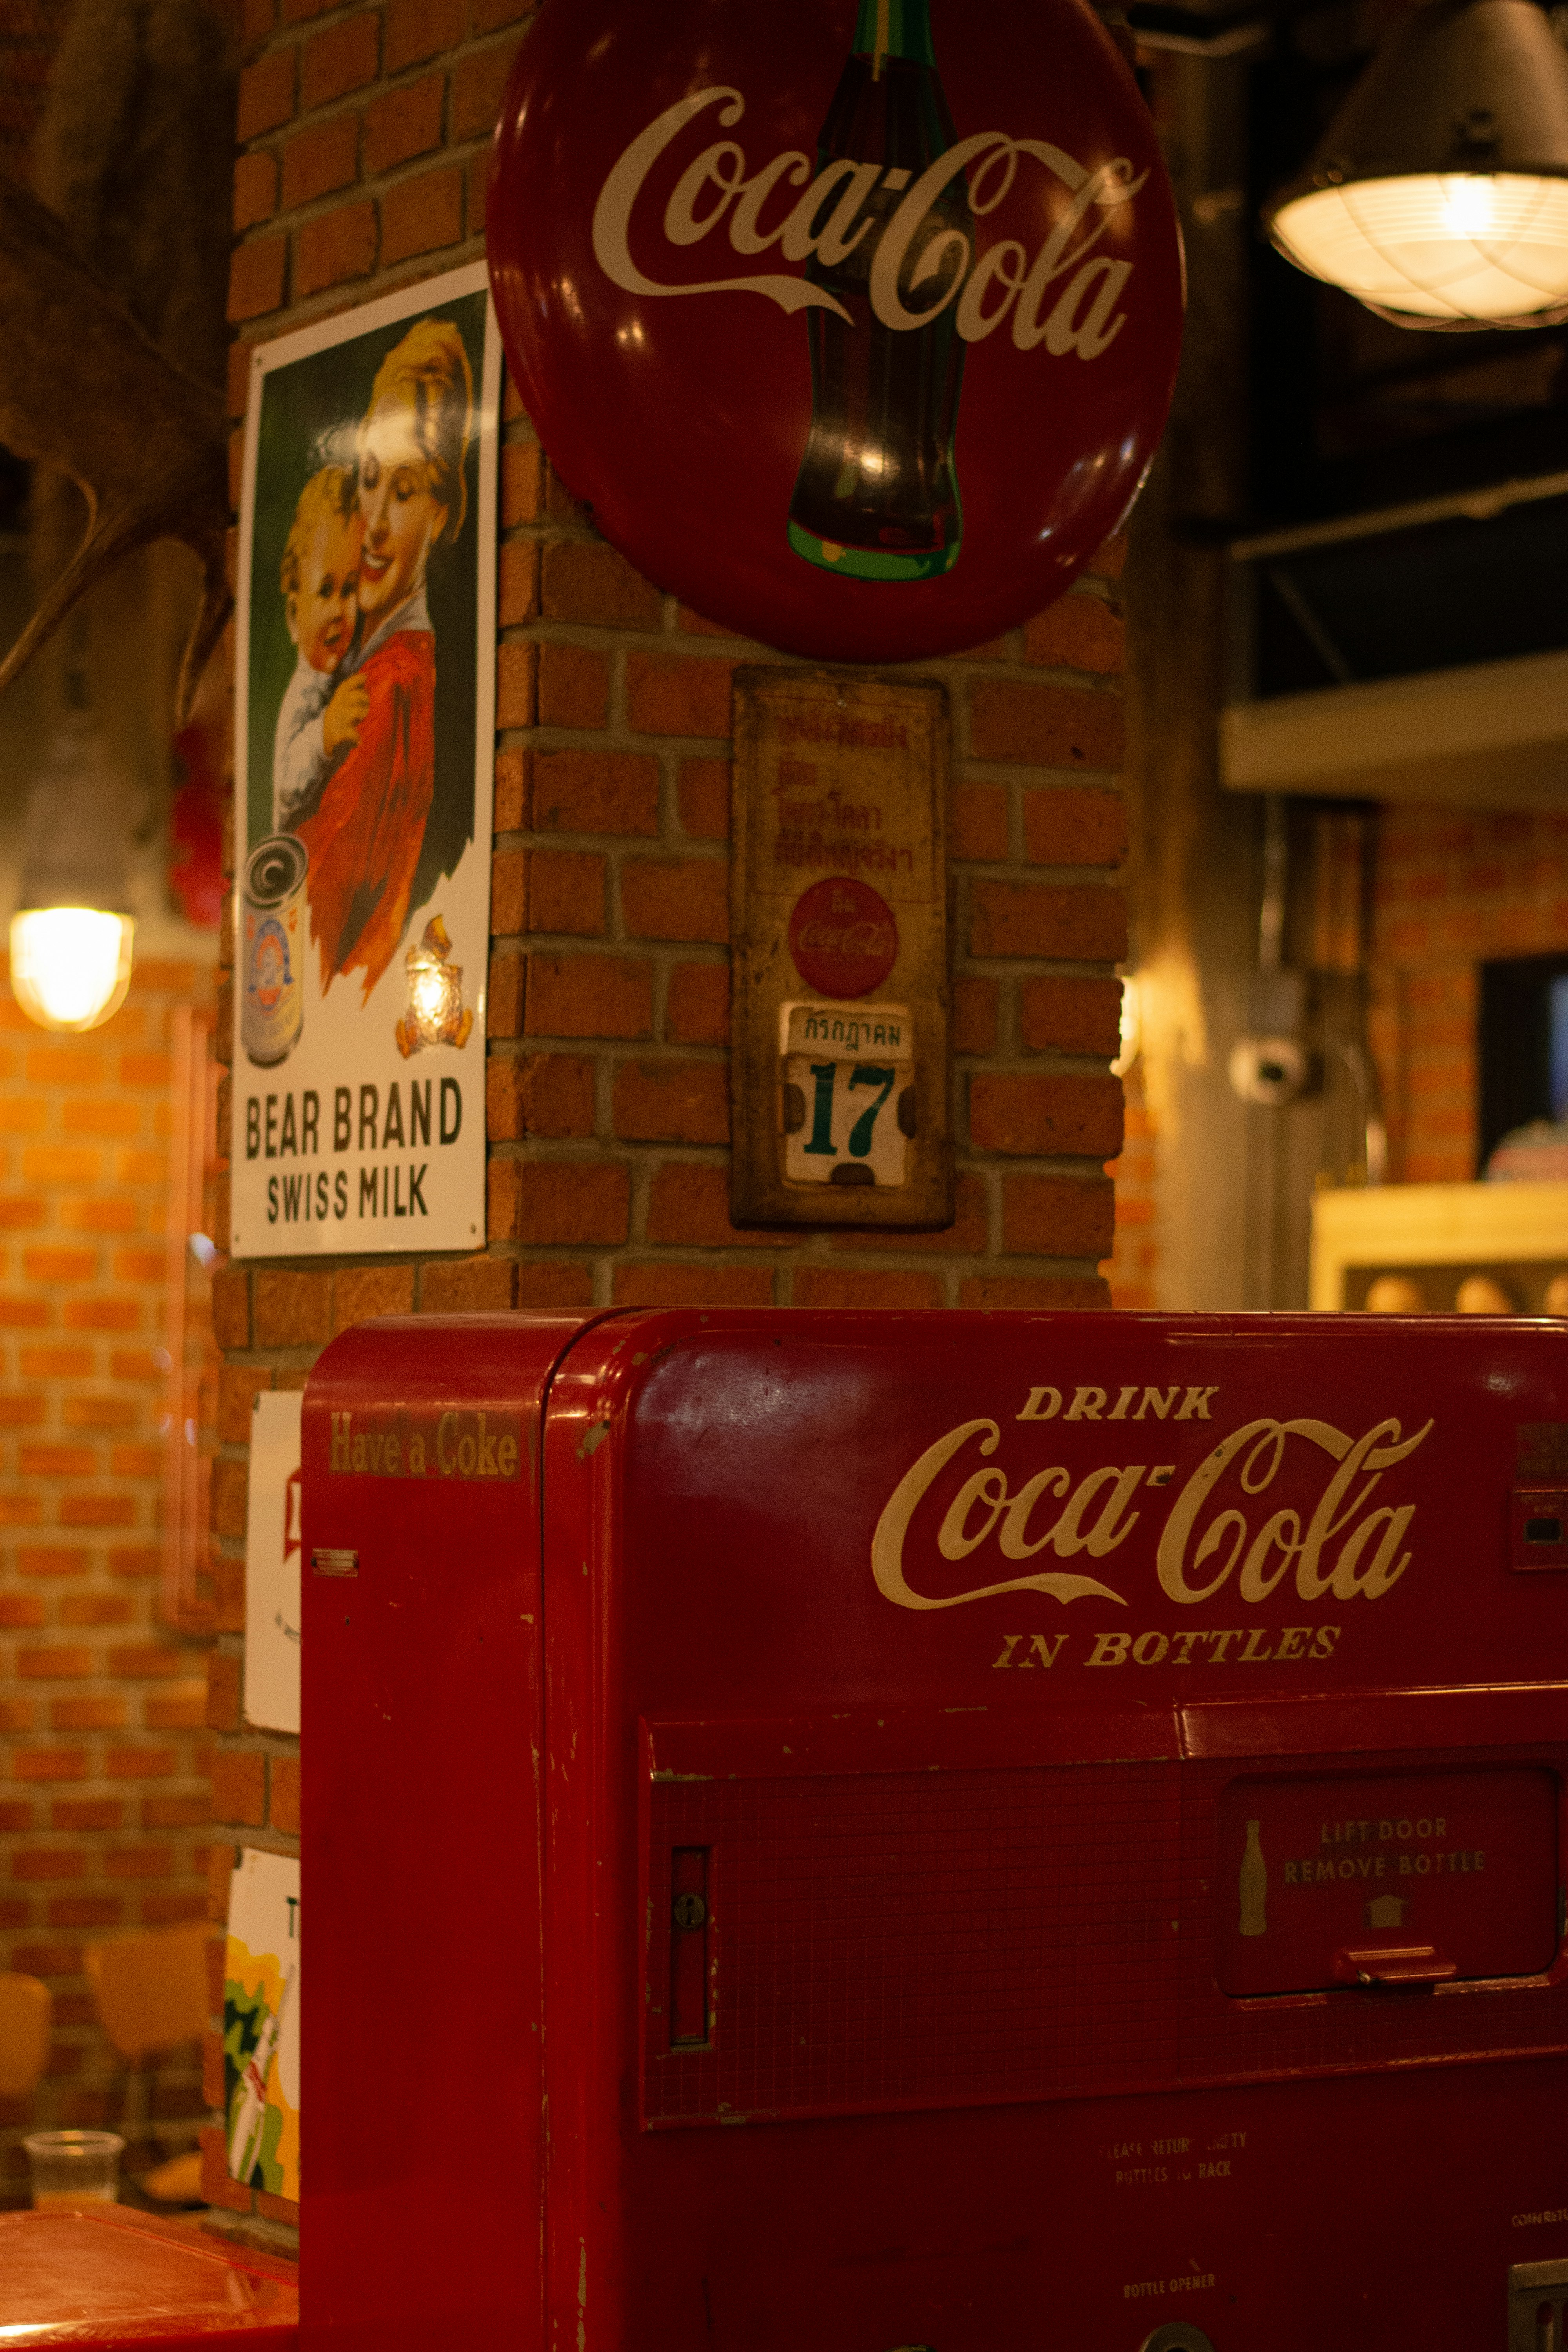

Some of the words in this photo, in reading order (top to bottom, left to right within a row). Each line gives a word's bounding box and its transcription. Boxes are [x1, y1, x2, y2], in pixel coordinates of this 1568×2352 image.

[591, 85, 1150, 360] Coca-Cola
[805, 1018, 900, 1051] กรกฎาคม
[247, 1091, 320, 1160] BEAR
[334, 1077, 462, 1152] BRAND
[803, 1062, 895, 1158] 17
[268, 1169, 347, 1225] SWISS
[359, 1163, 429, 1218] MILK
[1015, 1386, 1220, 1420] DRINK
[330, 1412, 401, 1472] Have
[410, 1434, 426, 1473] a
[437, 1412, 518, 1475] Coke
[871, 1417, 1434, 1610] Coca-Cola
[991, 1634, 1069, 1669] IN
[1083, 1625, 1342, 1667] BOTTLES
[1321, 1820, 1368, 1844] LIFT
[1379, 1817, 1447, 1840] DOOR
[1284, 1857, 1386, 1884] REMOVE
[1399, 1851, 1485, 1875] BOTTLE
[1198, 2160, 1231, 2178] RACK
[1512, 2212, 1542, 2227] COIN
[1123, 2280, 1165, 2299] BOTTLE
[1169, 2273, 1215, 2292] OPENER
